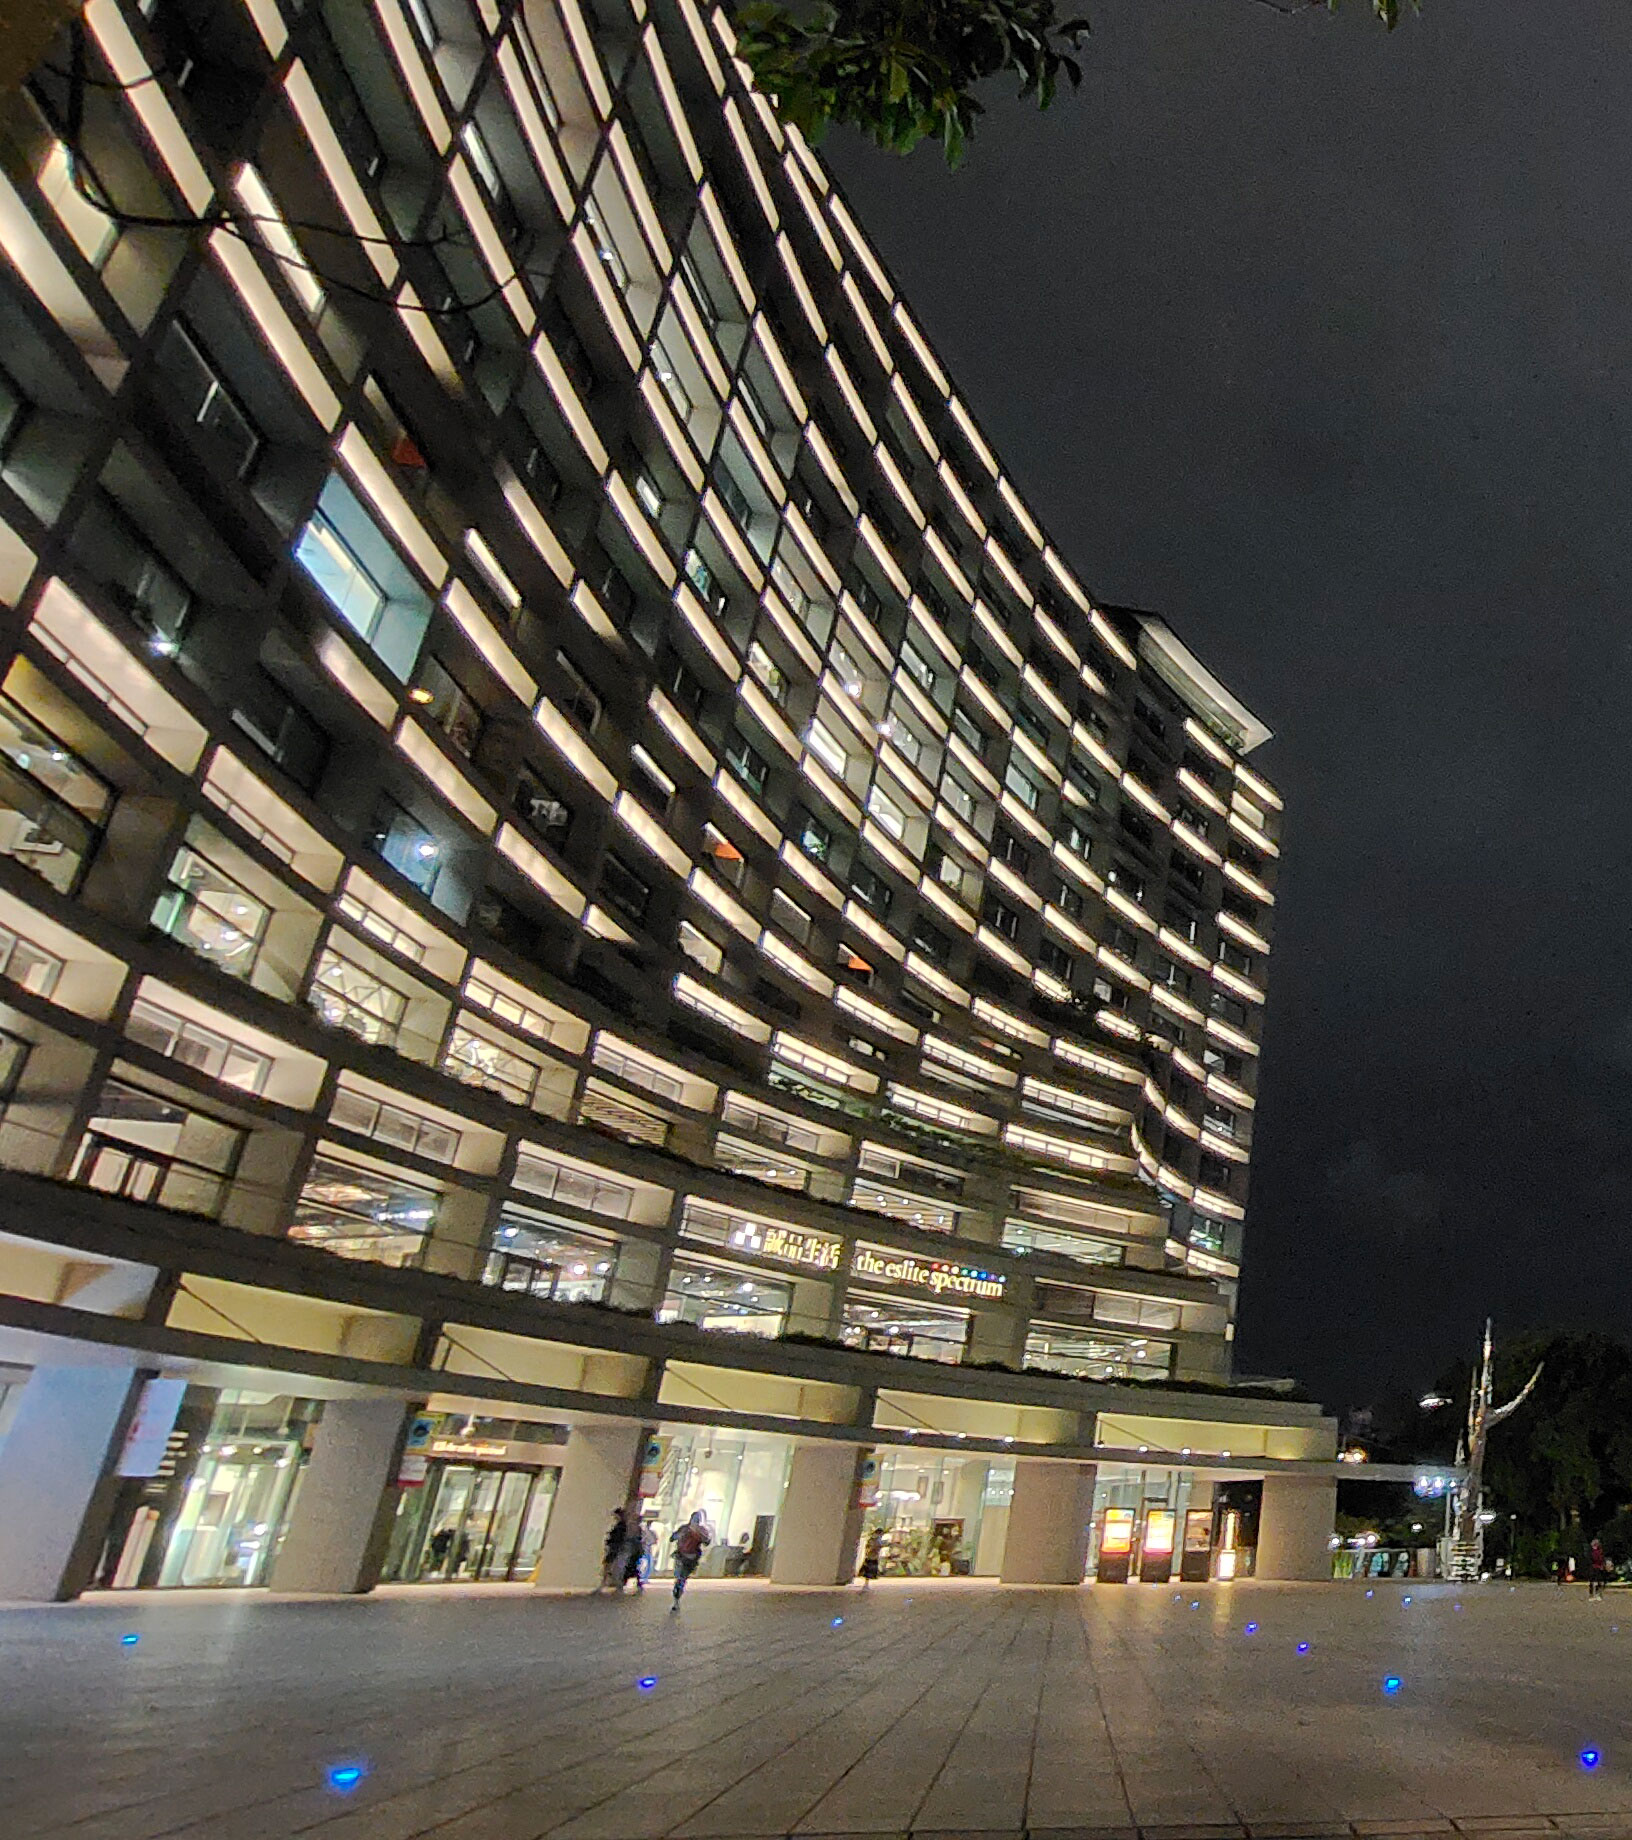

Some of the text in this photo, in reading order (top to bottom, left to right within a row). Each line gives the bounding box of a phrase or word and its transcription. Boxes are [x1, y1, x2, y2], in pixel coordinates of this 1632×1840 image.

[763, 1228, 841, 1269] 誠品生活
[856, 1250, 1003, 1297] the eslite spectrum
